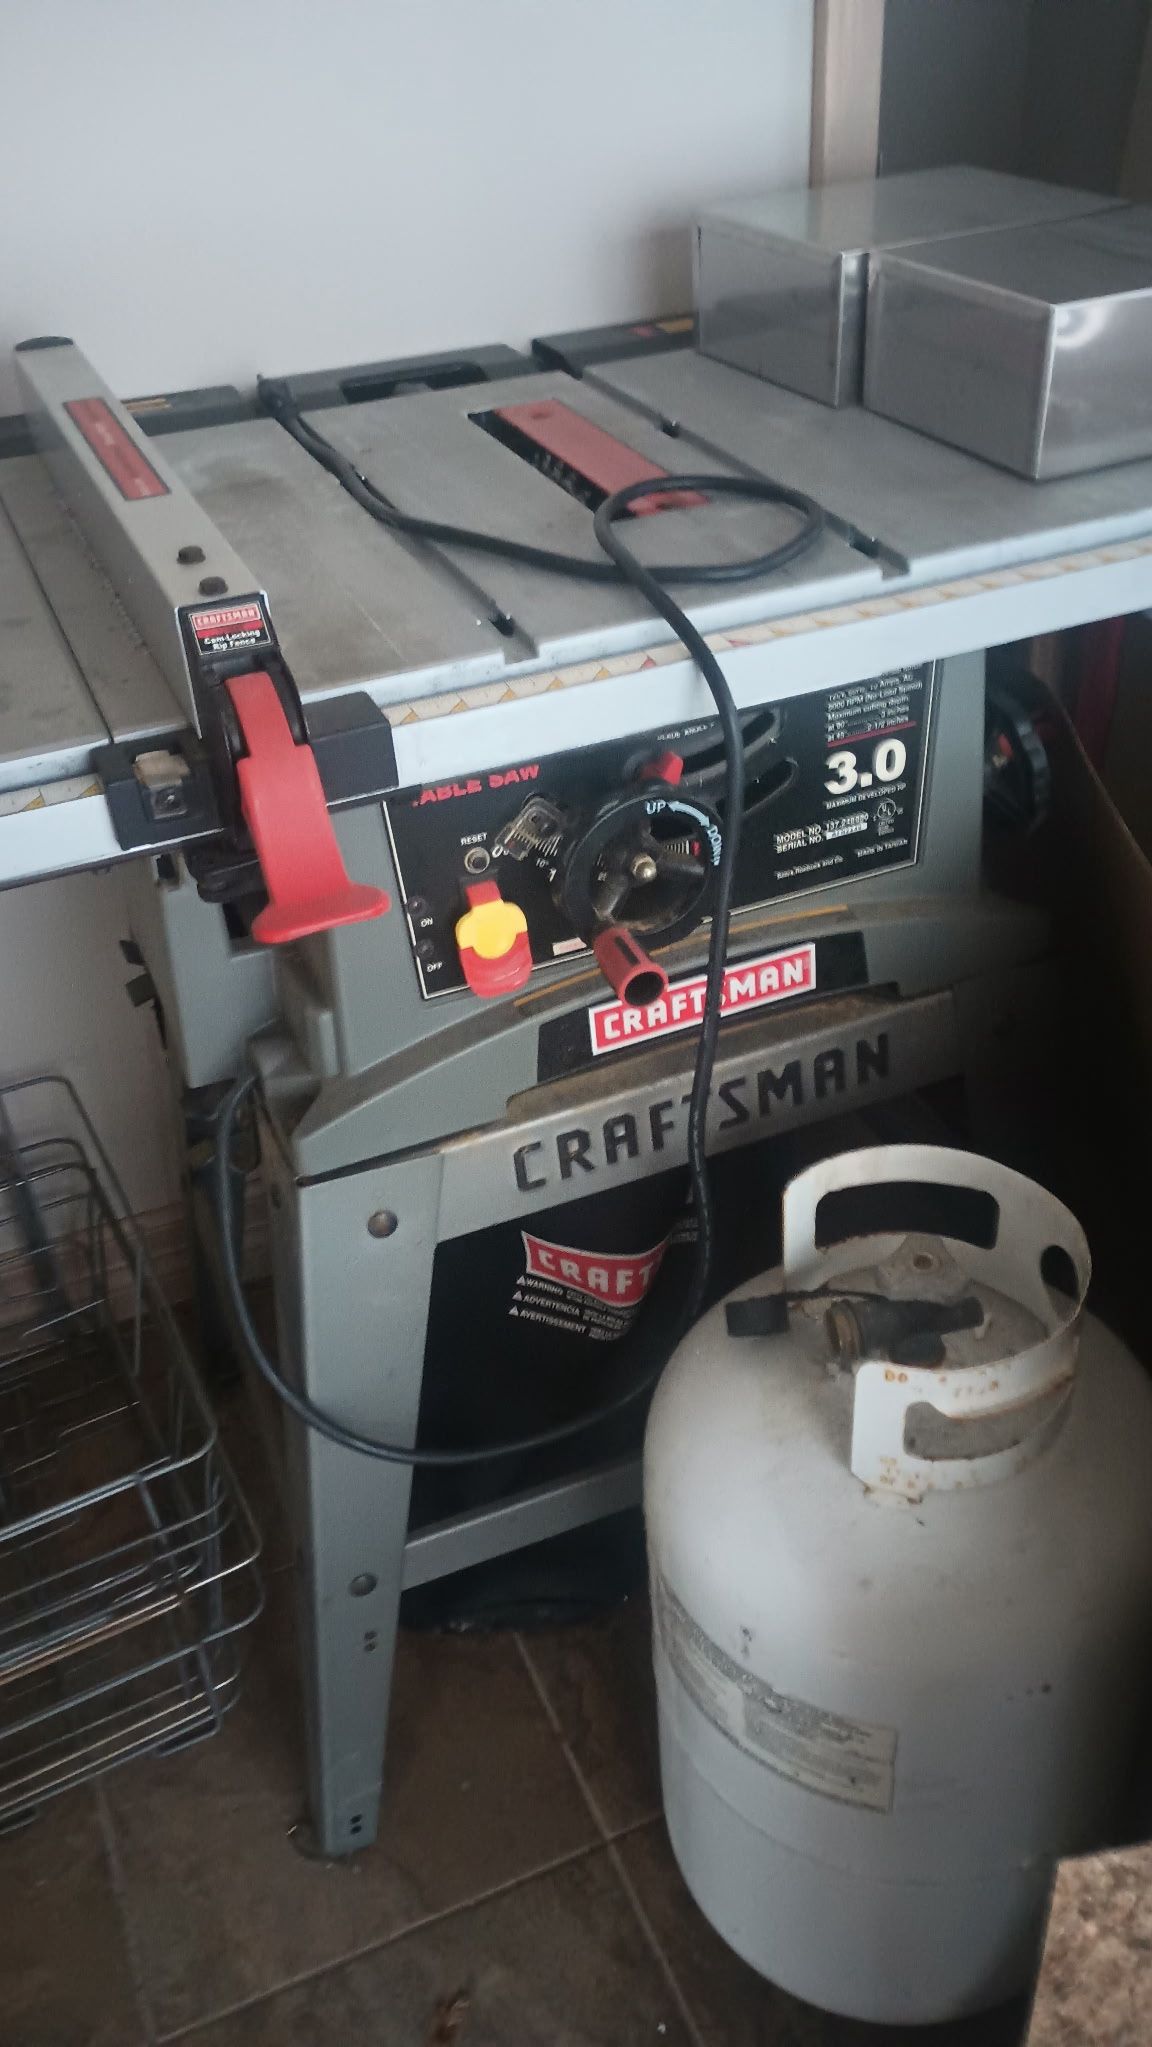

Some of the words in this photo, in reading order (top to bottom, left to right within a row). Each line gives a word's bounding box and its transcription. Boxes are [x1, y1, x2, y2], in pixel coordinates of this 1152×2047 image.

[824, 737, 907, 796] 3.0
[412, 779, 483, 807] ABLE
[488, 764, 541, 789] SAW
[644, 799, 667, 815] UP
[460, 832, 488, 847] RESET
[706, 823, 722, 867] DOWN
[776, 828, 807, 845] MODEL
[776, 838, 808, 855] SERIAL
[420, 917, 434, 928] ON
[427, 961, 443, 973] OFF
[512, 1032, 891, 1193] CRAFSMAN
[537, 1249, 660, 1296] CRAFT
